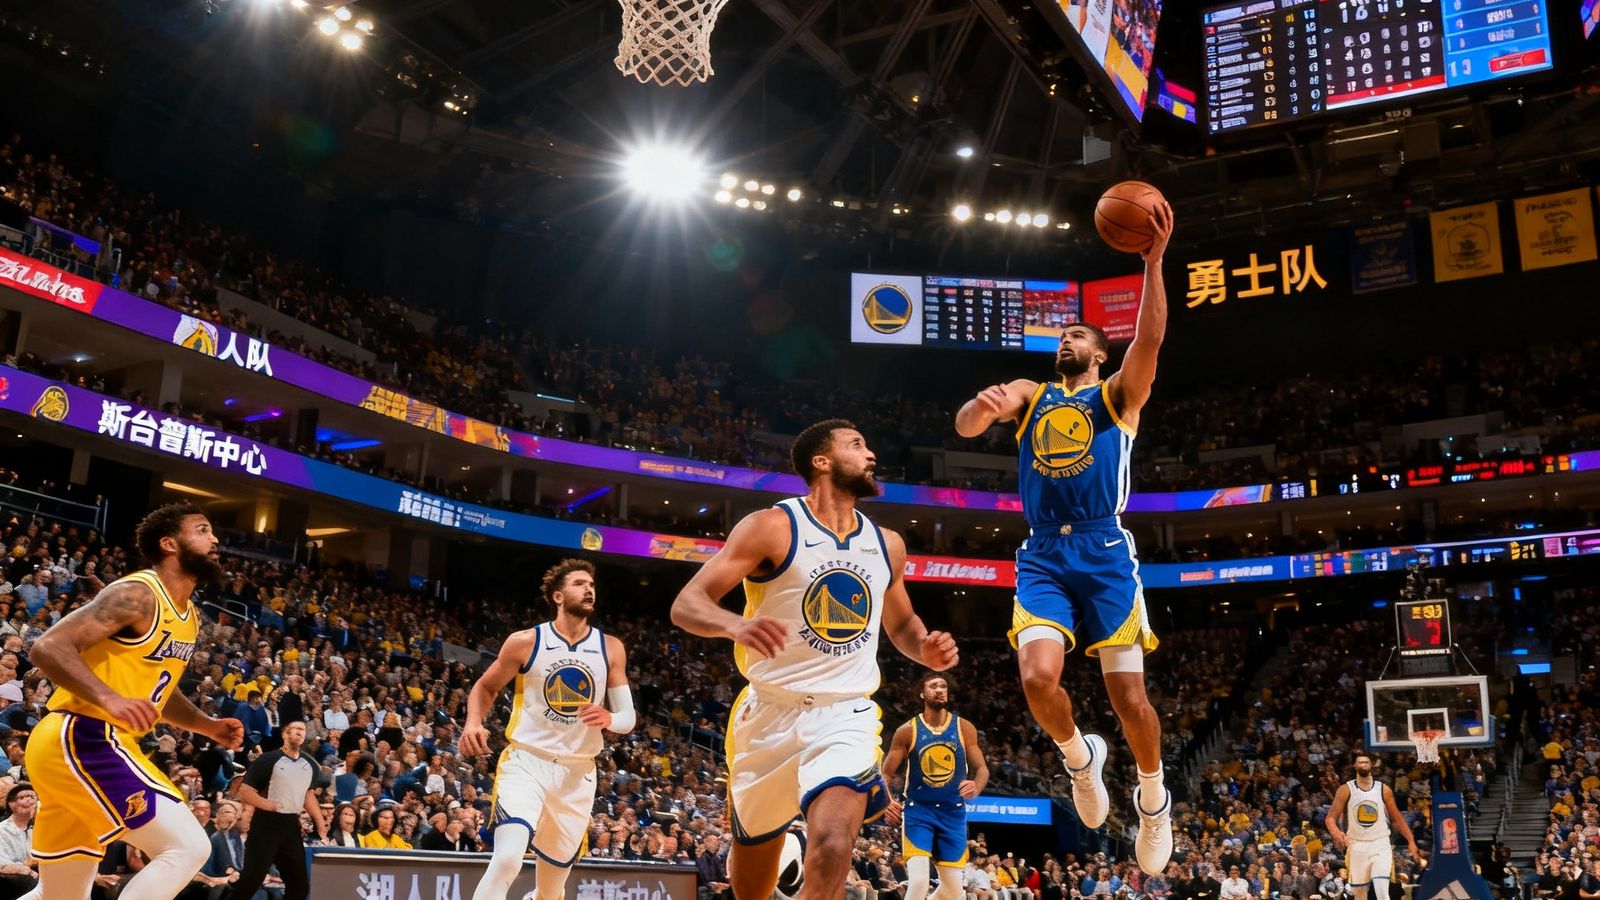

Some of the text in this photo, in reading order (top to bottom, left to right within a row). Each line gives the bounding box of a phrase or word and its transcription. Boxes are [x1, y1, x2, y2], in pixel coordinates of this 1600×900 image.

[1185, 244, 1328, 309] 勇士队
[217, 331, 273, 377] 人队
